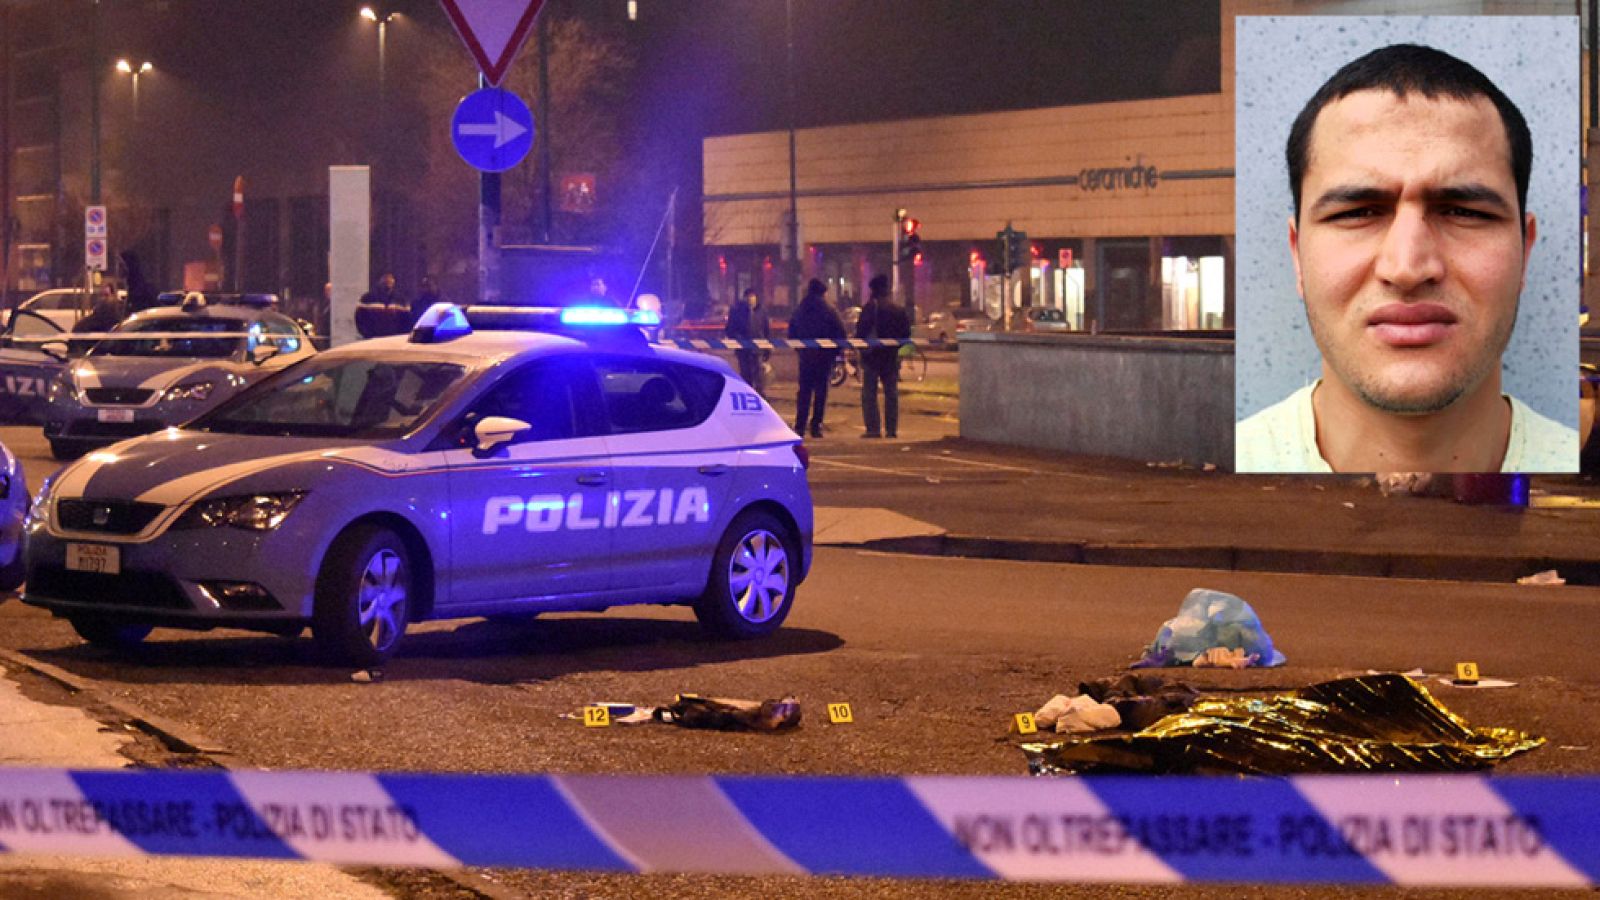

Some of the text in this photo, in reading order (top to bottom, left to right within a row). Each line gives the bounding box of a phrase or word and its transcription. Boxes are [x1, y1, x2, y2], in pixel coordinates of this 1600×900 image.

[1079, 153, 1157, 191] ceramiche
[729, 391, 762, 411] 113
[482, 486, 709, 535] POLIZIA
[1463, 664, 1472, 677] 6
[588, 708, 606, 722] 12
[832, 705, 848, 719] 10
[1021, 714, 1031, 729] 9
[22, 799, 198, 836] OLTREPASSARE
[213, 802, 306, 839] POLIZIA
[311, 804, 336, 842] DI
[340, 804, 420, 842] STATO
[954, 813, 1015, 852] NON
[1022, 813, 1254, 856] OLTREPASSARE
[1279, 814, 1394, 857] POLIZIA
[1402, 814, 1433, 858] DI
[1440, 814, 1543, 858] STATO
